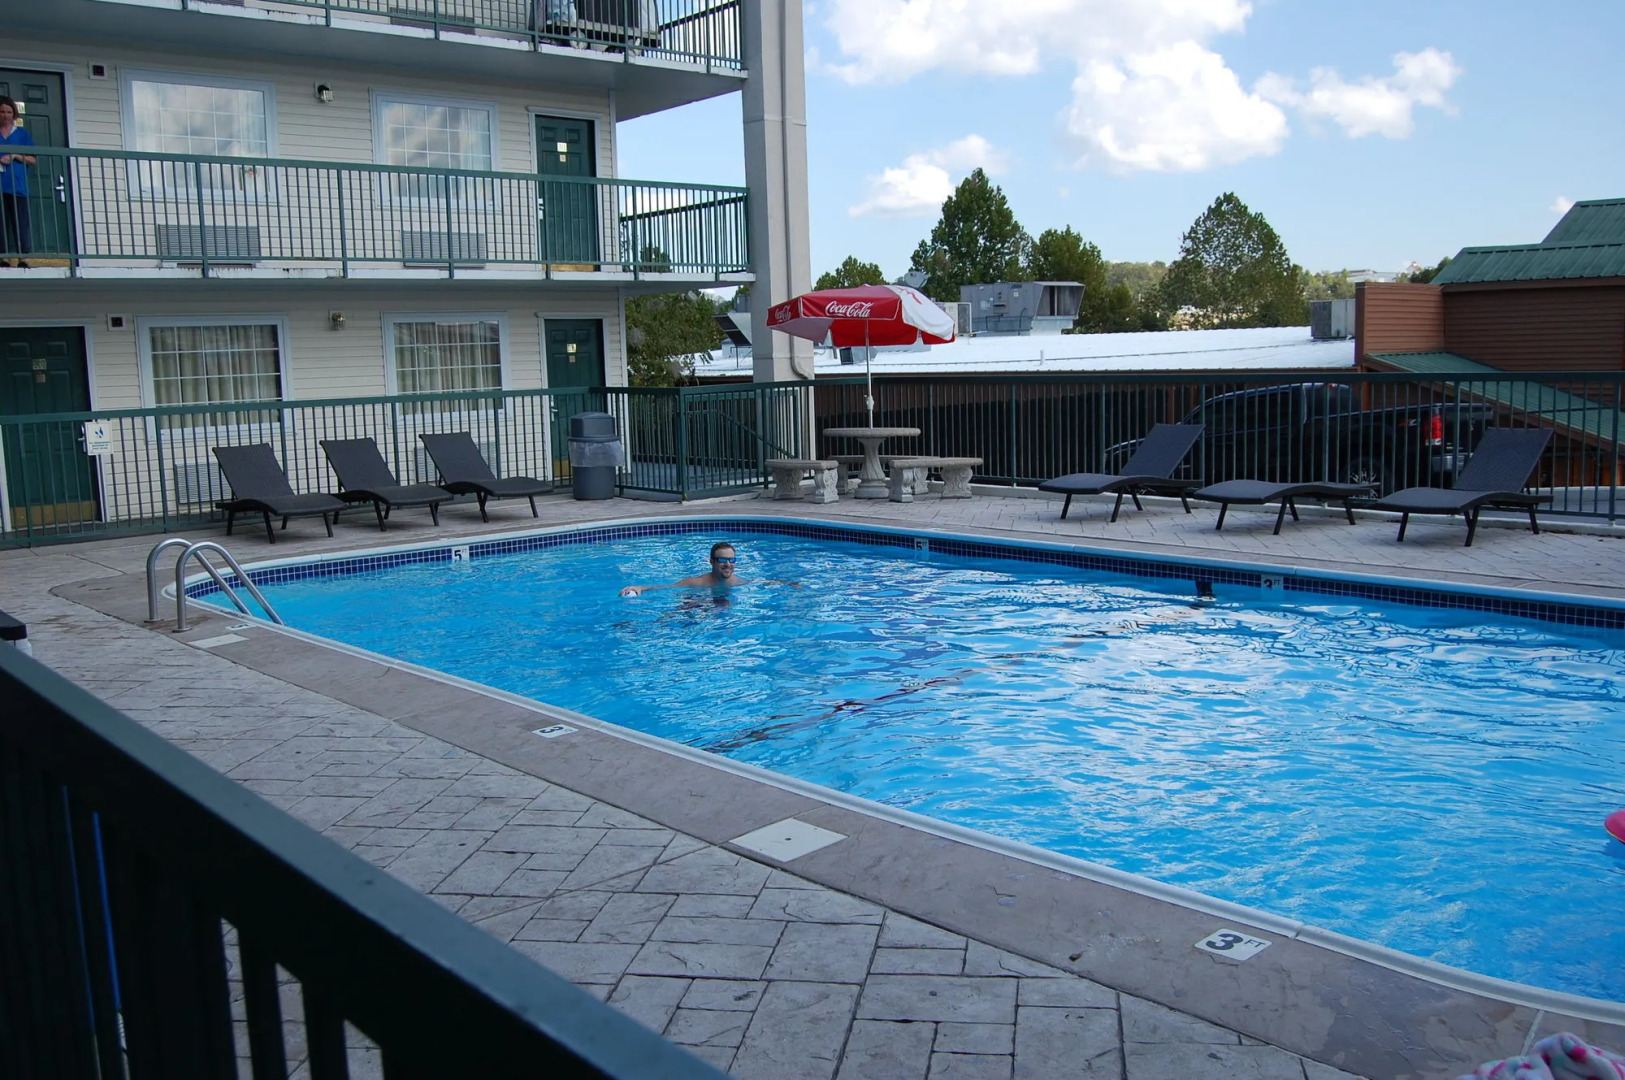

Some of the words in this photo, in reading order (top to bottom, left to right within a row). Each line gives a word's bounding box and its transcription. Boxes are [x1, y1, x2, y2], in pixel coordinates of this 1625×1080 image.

[825, 300, 874, 318] Coca-Cola
[539, 726, 564, 734] 3
[1205, 933, 1243, 951] 3
[1244, 939, 1266, 948] FT
